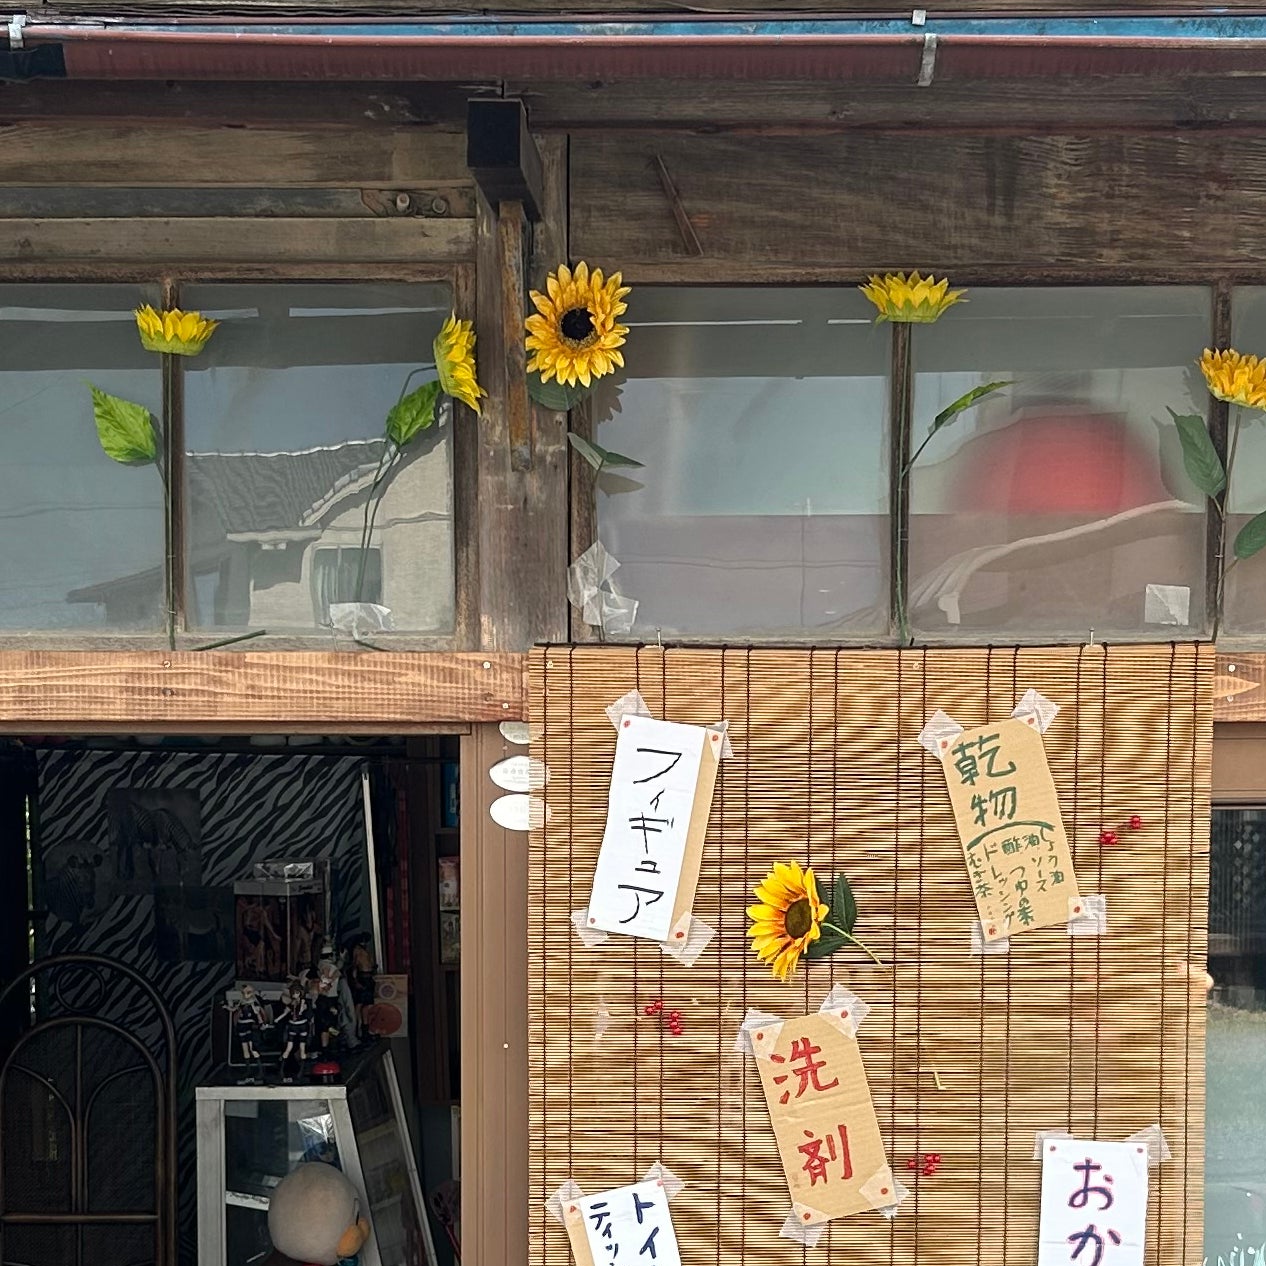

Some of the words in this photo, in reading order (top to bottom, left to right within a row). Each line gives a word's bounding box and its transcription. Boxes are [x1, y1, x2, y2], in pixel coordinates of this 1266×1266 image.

[617, 747, 683, 924] フィギュア
[951, 732, 1017, 827] 乾物
[772, 1036, 853, 1187] 洗剤
